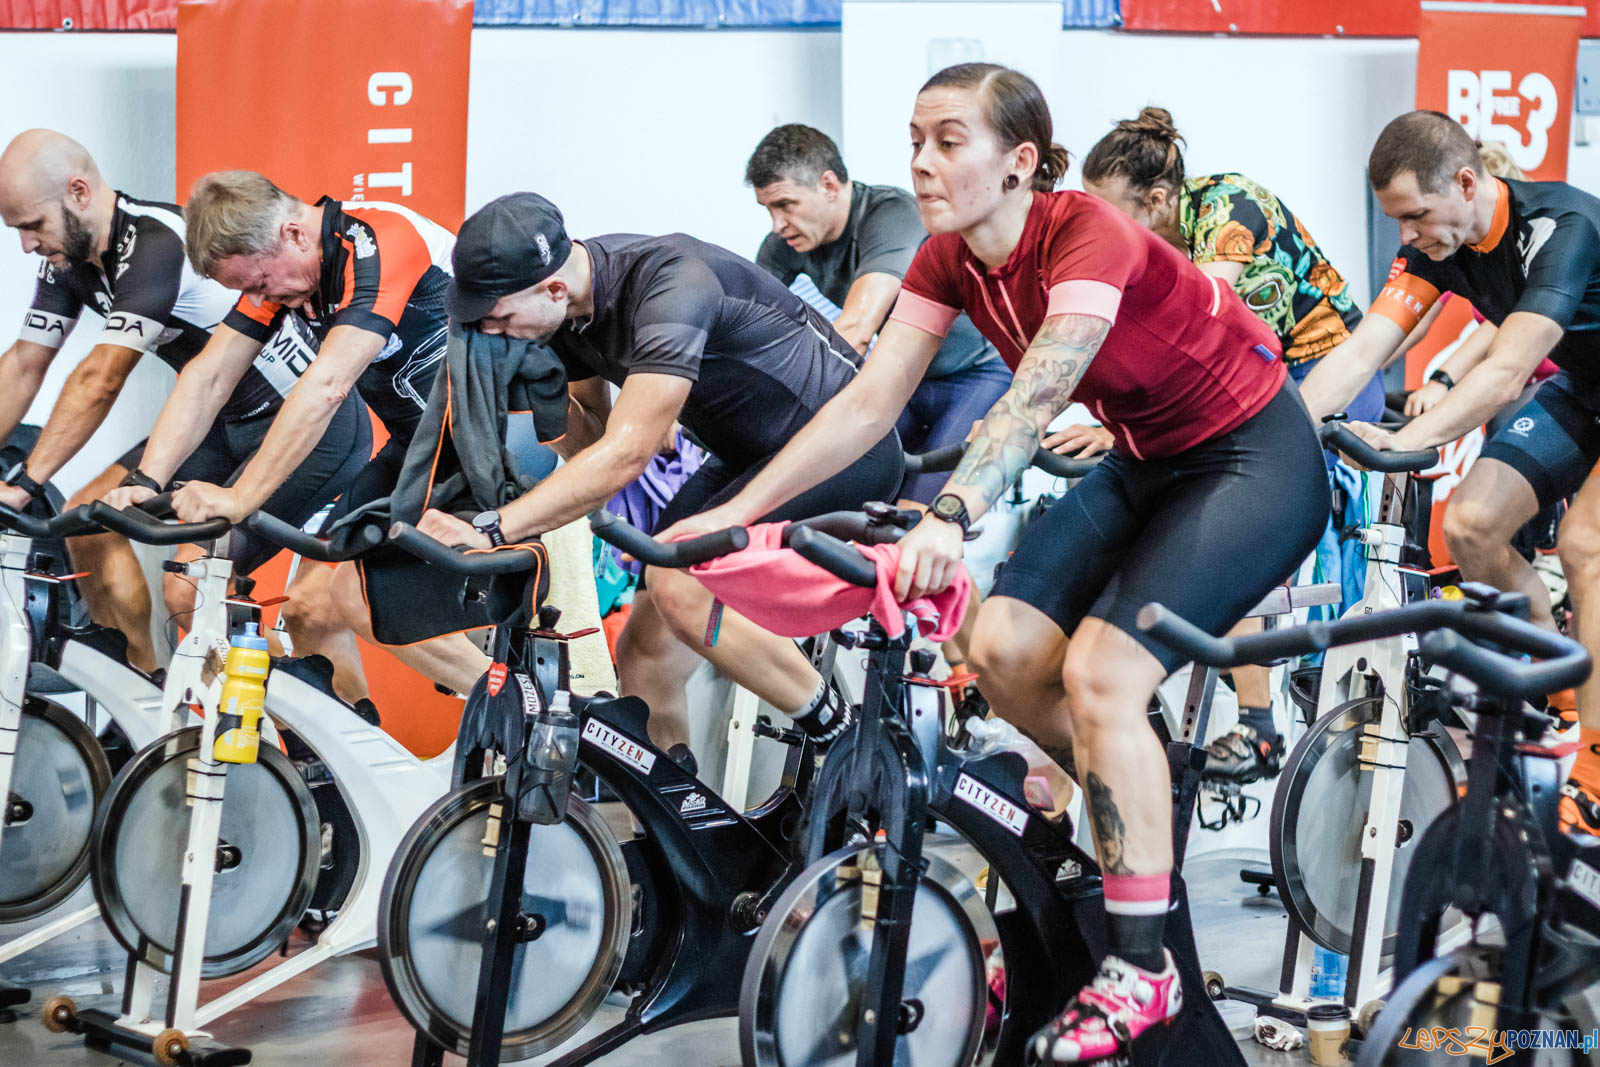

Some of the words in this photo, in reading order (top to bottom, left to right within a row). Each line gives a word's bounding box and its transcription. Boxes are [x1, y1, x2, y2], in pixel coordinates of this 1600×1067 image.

[368, 71, 413, 196] CIT
[586, 722, 645, 761] CITYZEN
[959, 778, 1016, 822] CITYZEN
